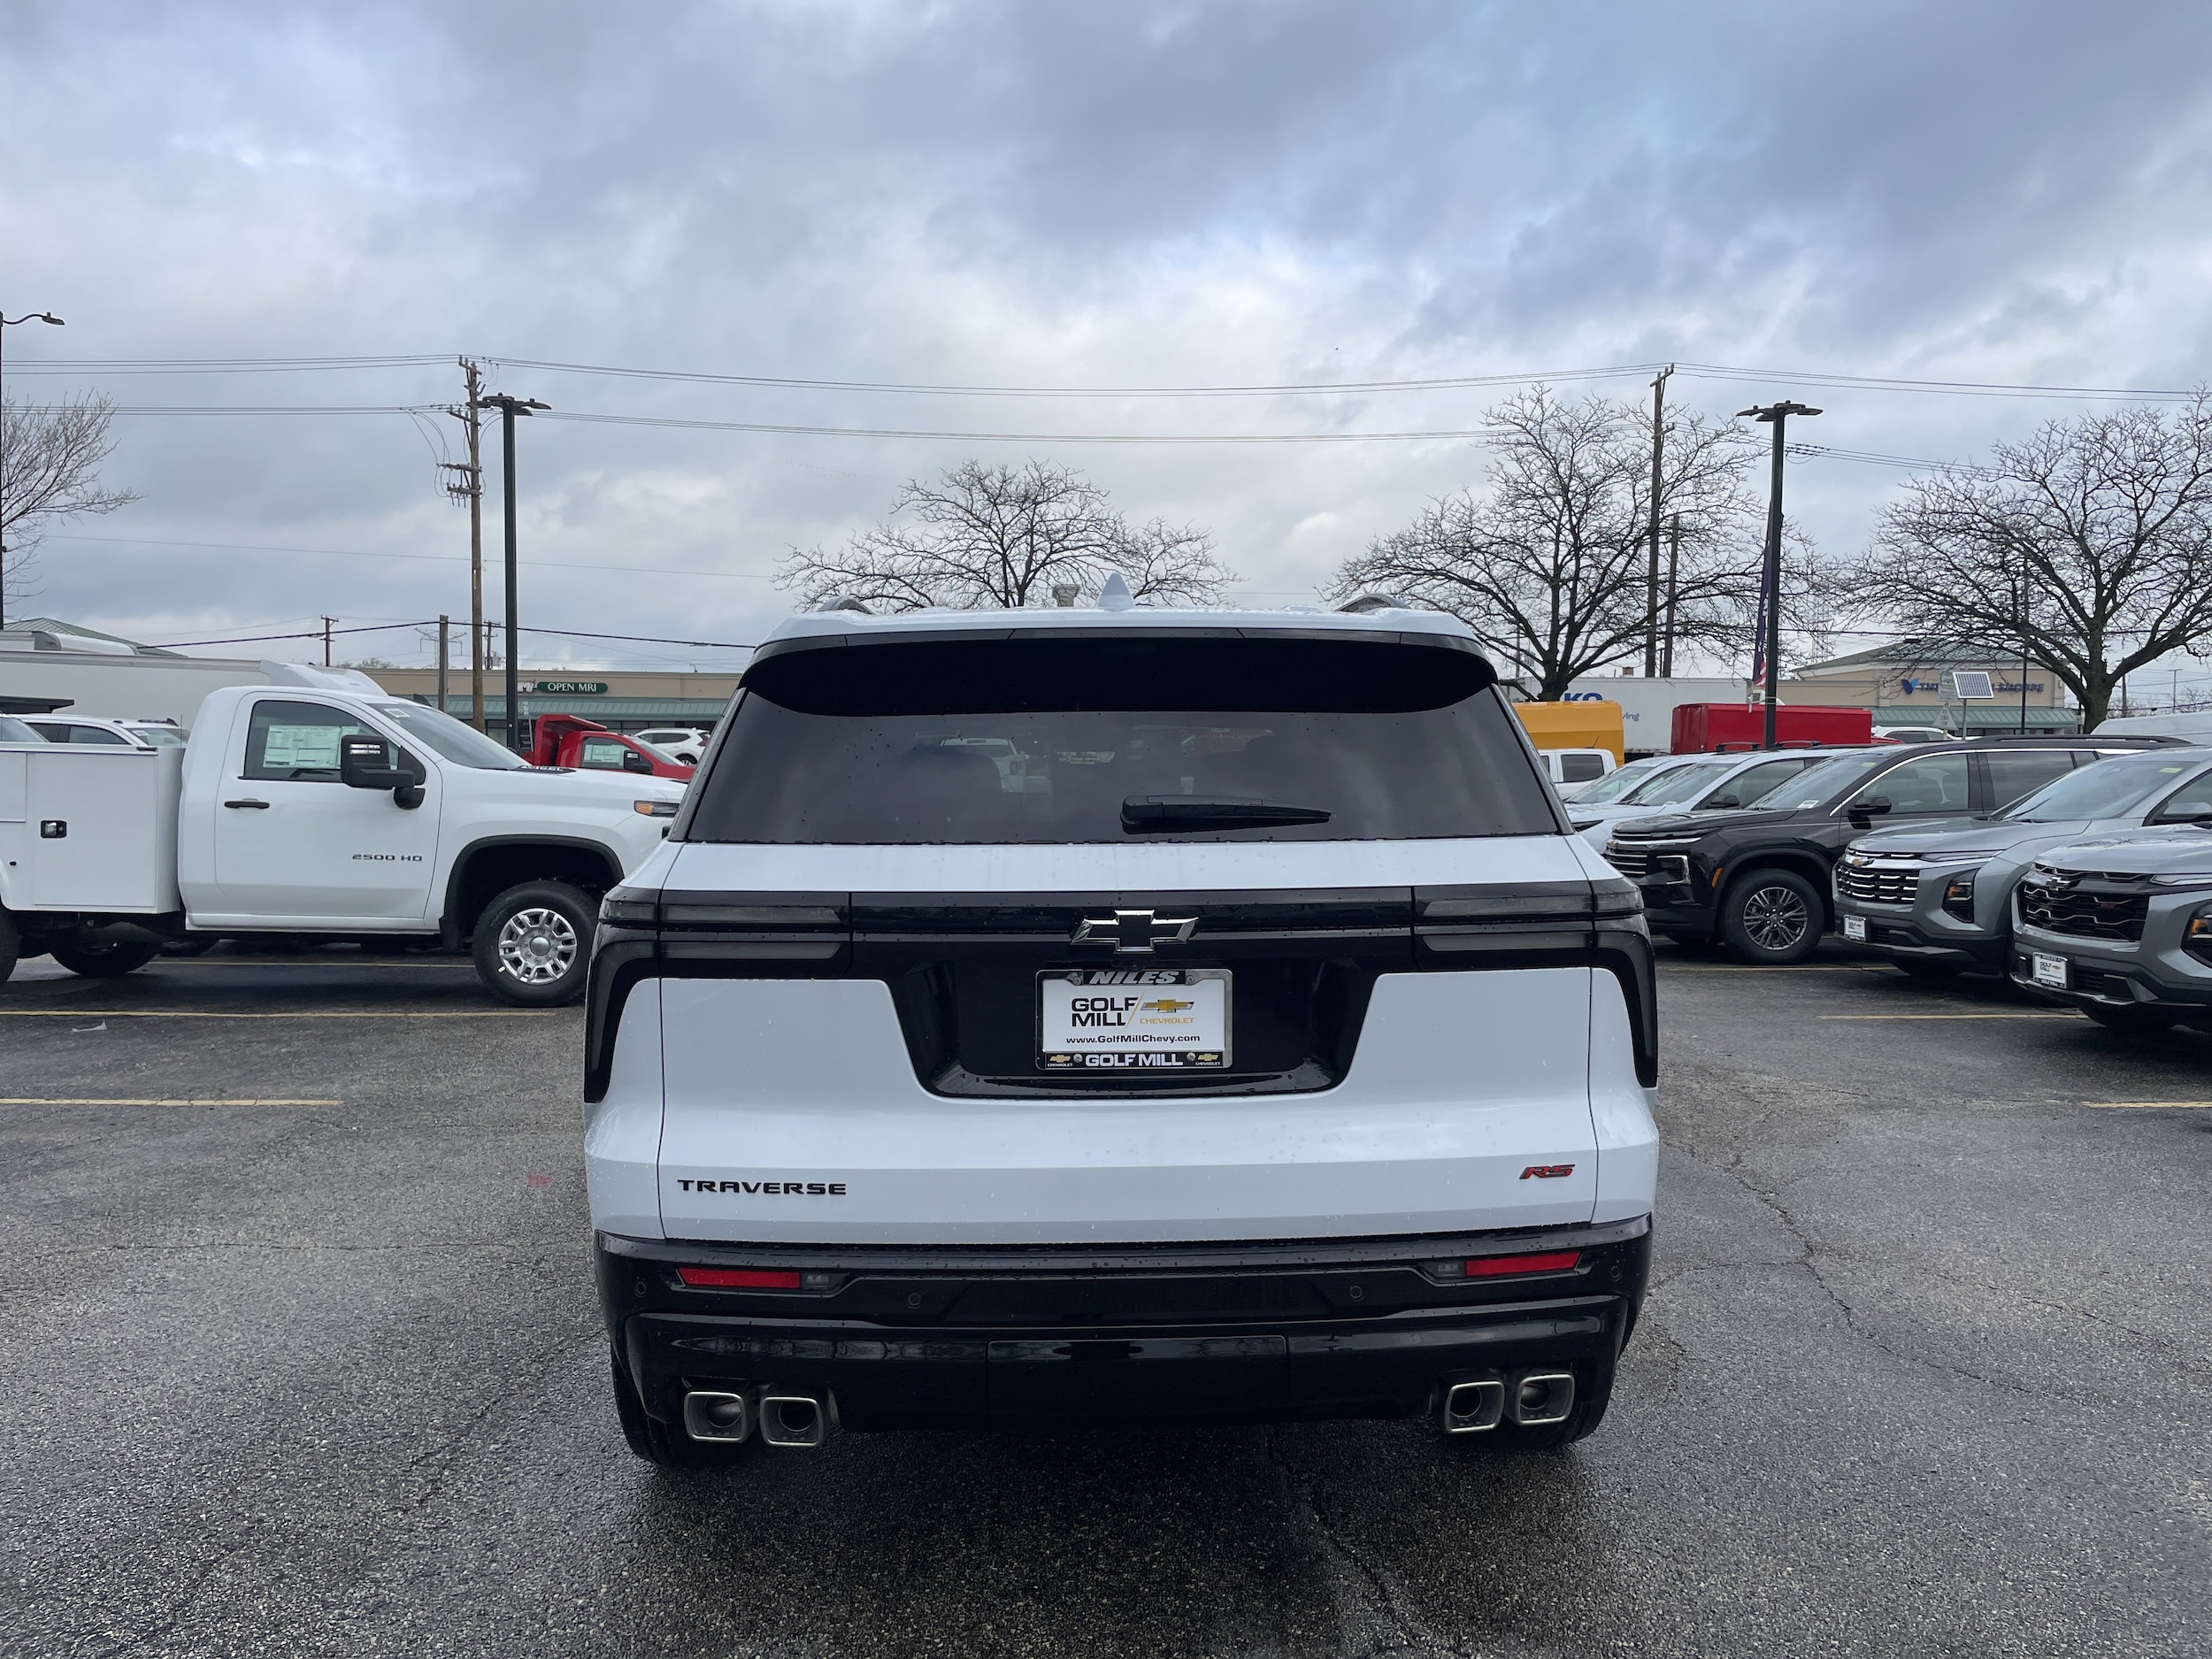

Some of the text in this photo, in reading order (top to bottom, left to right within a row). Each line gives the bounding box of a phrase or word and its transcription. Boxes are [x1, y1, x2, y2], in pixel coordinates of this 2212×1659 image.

[548, 682, 574, 692] OPEN
[578, 683, 597, 692] MRI
[1089, 971, 1179, 985] NILES
[1071, 997, 1140, 1012] GOLF
[1071, 1012, 1126, 1027] MILL
[1066, 1033, 1201, 1044] www.GolfMillChevy.com
[1085, 1053, 1184, 1067] GOLF MILL
[1519, 1164, 1575, 1179] RS
[677, 1179, 847, 1195] TRAVERSE
